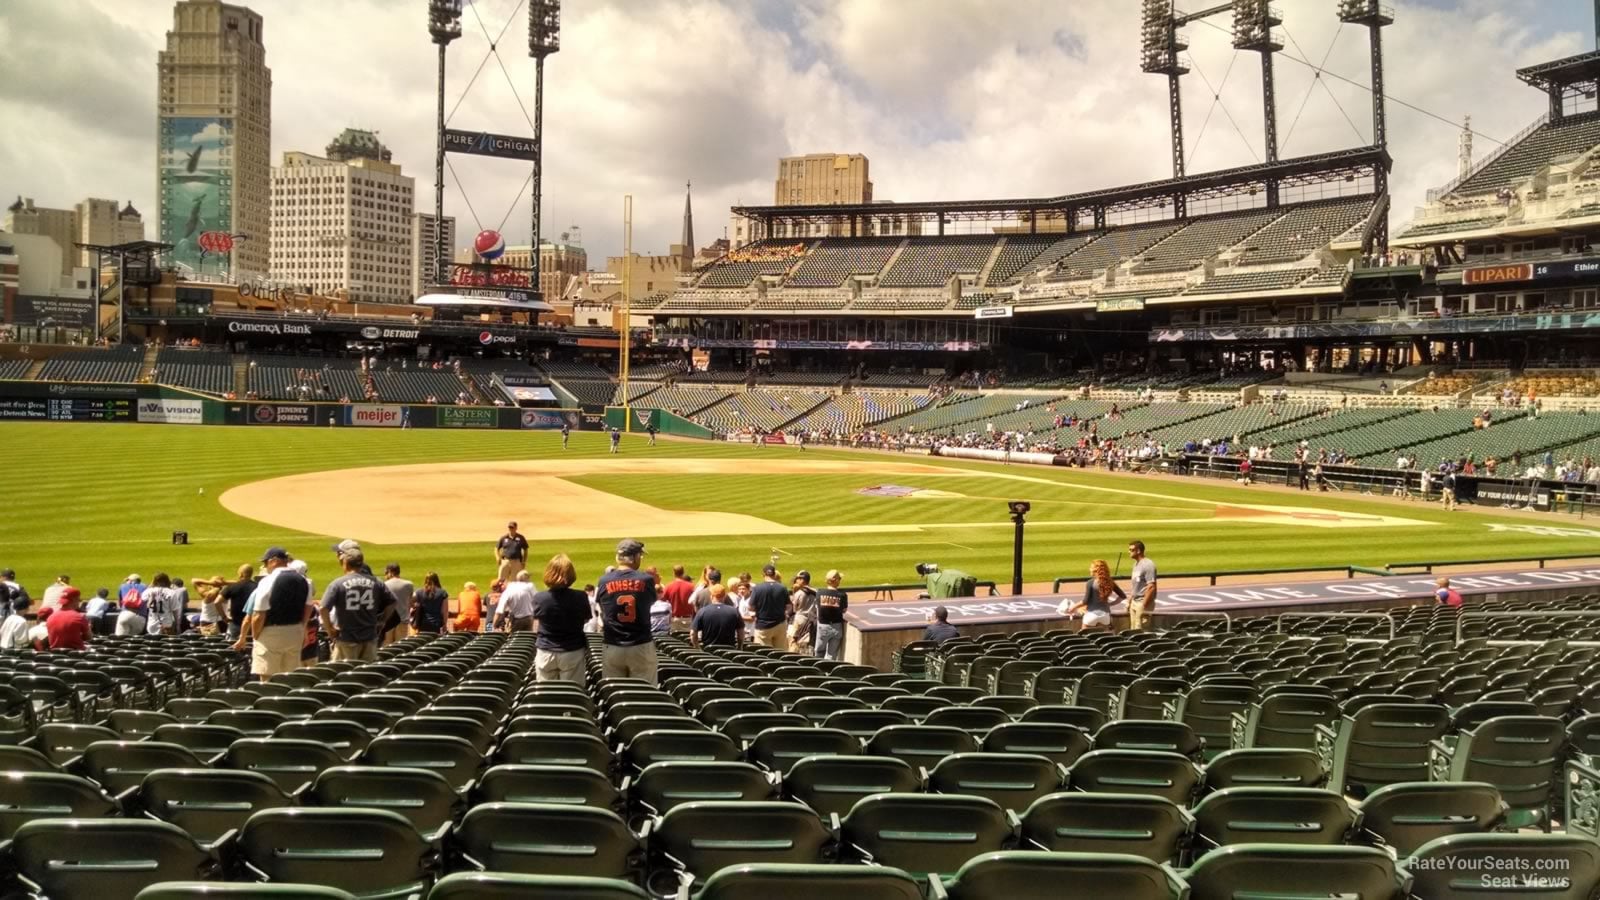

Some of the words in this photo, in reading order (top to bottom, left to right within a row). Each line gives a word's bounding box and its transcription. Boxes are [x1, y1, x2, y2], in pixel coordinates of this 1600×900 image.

[445, 134, 473, 145] PURE
[467, 132, 540, 152] MICHIGAN
[1537, 266, 1547, 274] 16
[1574, 263, 1599, 271] Ethier
[1472, 267, 1522, 282] LIPARI
[283, 324, 311, 334] Bank
[383, 329, 420, 338] DETROIT
[493, 335, 516, 344] pepsi
[357, 411, 397, 423] meijer
[444, 407, 491, 418] EASTERN
[1325, 582, 1407, 598] OF
[346, 590, 374, 610] 24
[149, 600, 164, 613] 41
[617, 595, 636, 622] 3
